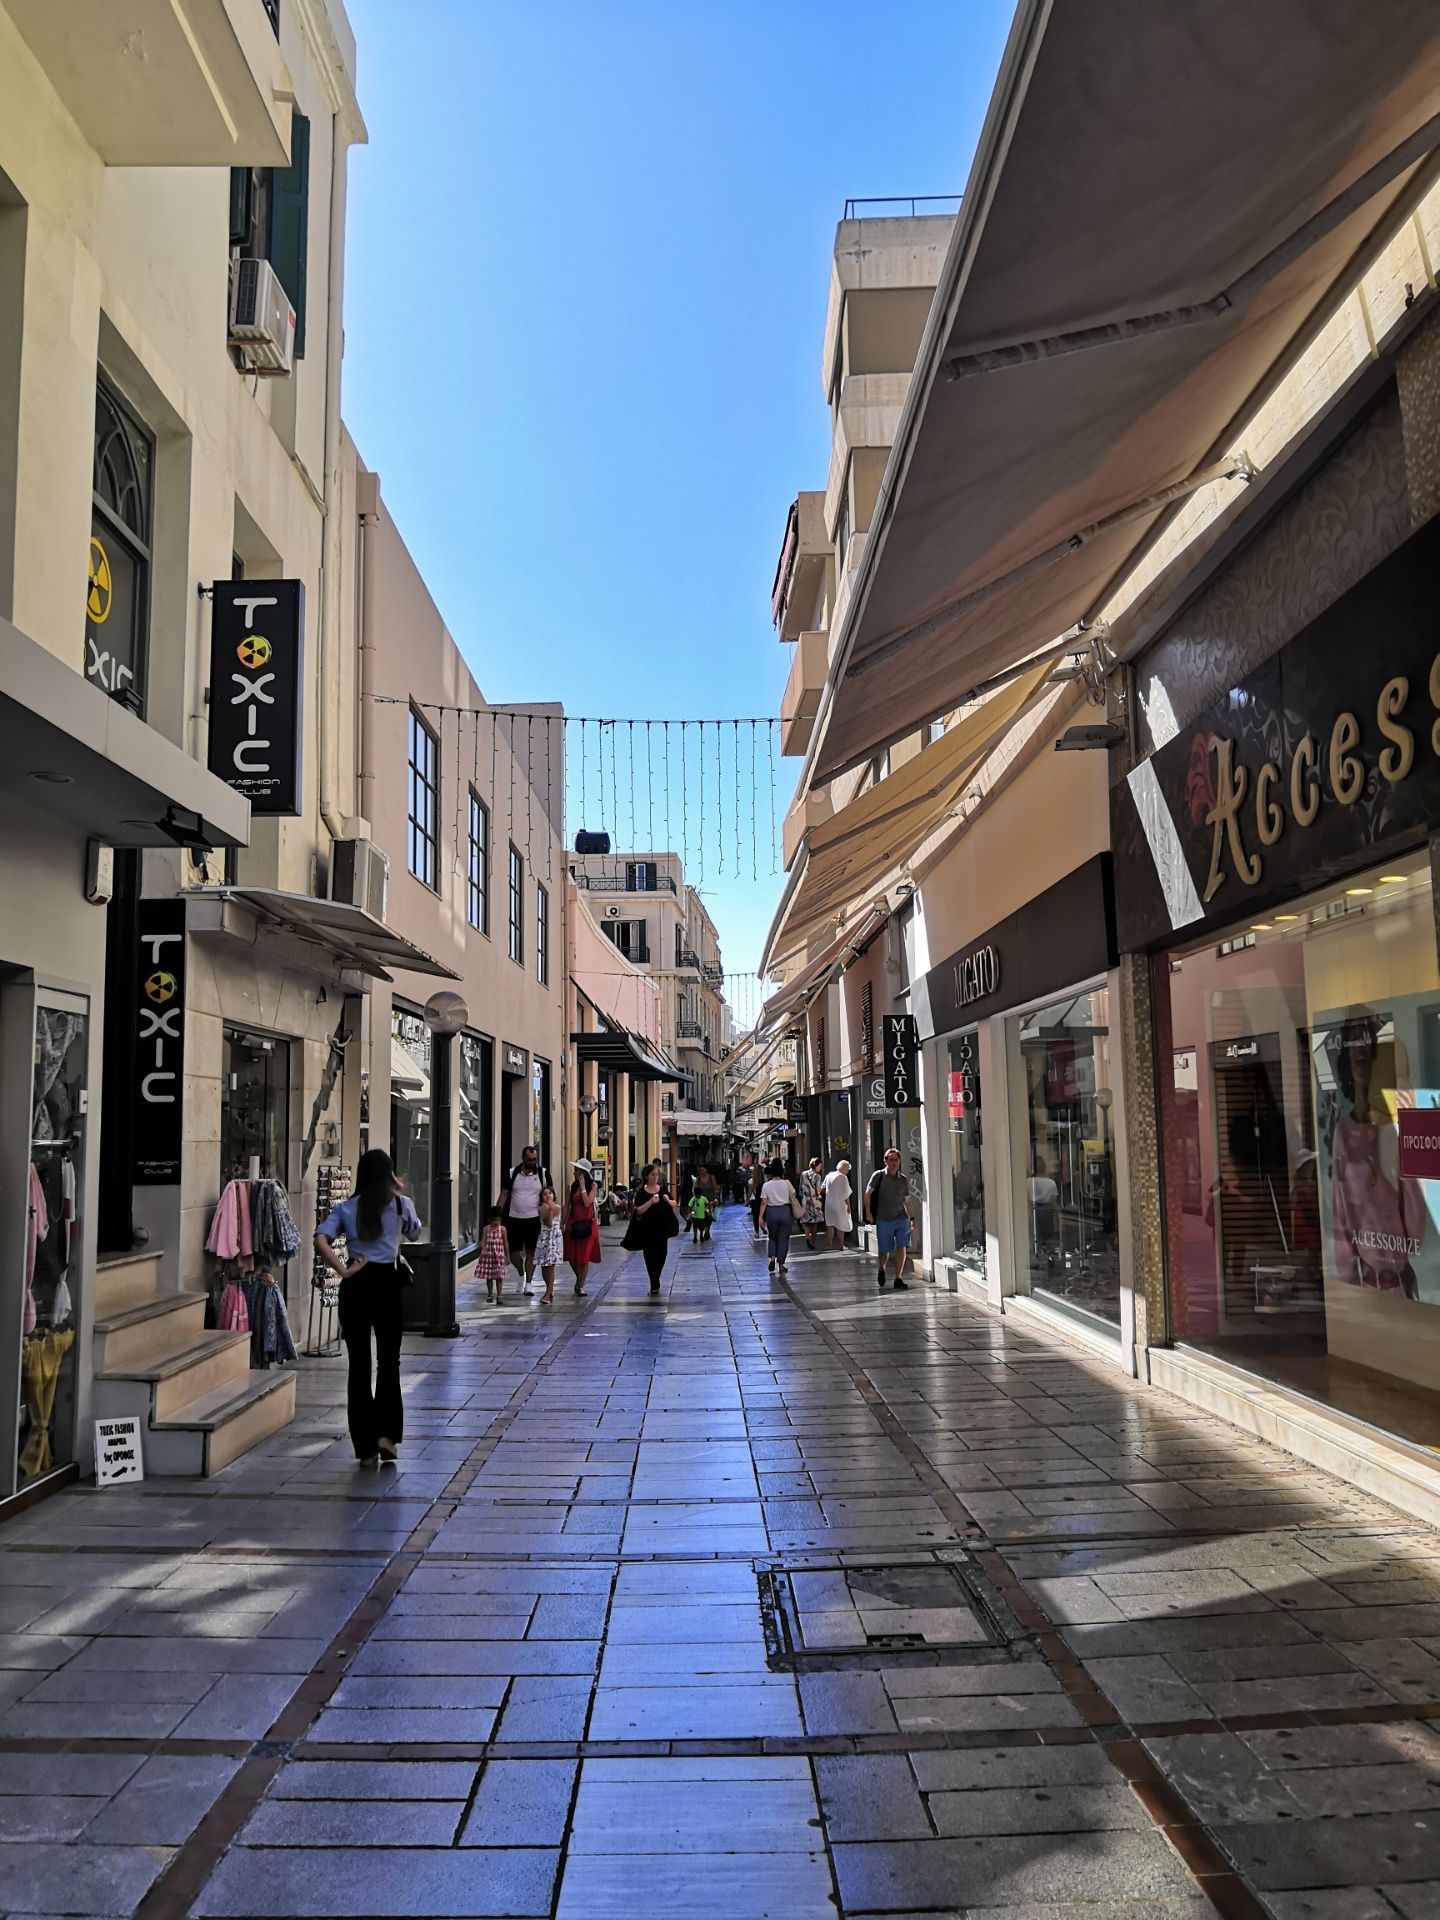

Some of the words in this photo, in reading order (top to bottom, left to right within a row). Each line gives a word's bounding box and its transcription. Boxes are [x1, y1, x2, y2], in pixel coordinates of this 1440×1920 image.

[226, 778, 281, 786] FASHION
[954, 945, 998, 1008] MIGATO
[891, 1018, 908, 1104] MIGATO
[1403, 1135, 1440, 1150] ΠΡΟΣΦΟ
[1351, 1229, 1421, 1256] ACCESSORIZE
[99, 1425, 114, 1437] TOXIC
[114, 1423, 134, 1434] FASHION
